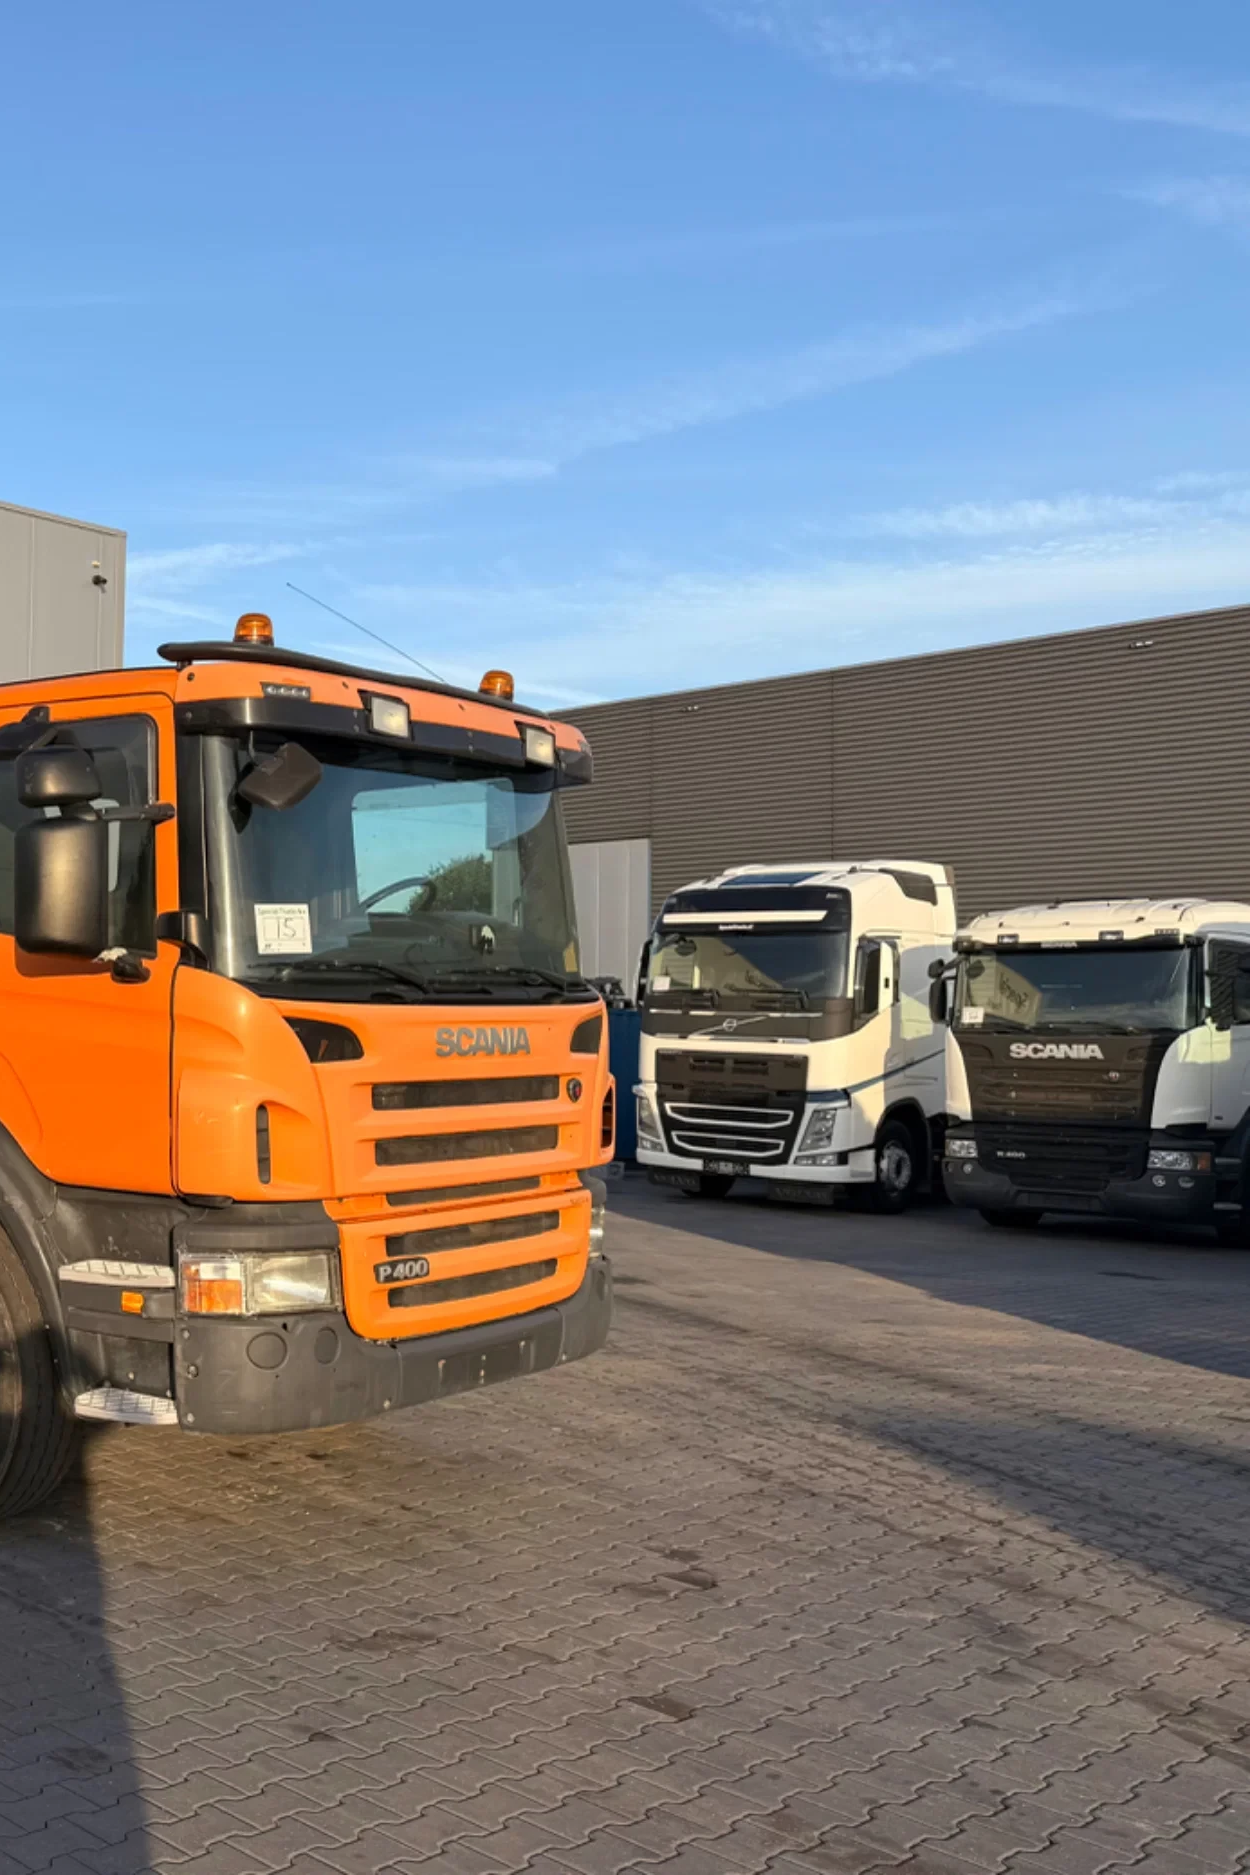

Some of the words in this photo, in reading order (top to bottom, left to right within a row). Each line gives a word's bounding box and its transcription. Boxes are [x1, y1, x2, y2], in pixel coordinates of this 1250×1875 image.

[276, 917, 297, 940] 15
[435, 1026, 531, 1057] SCANIA
[1009, 1042, 1104, 1060] SCANIA
